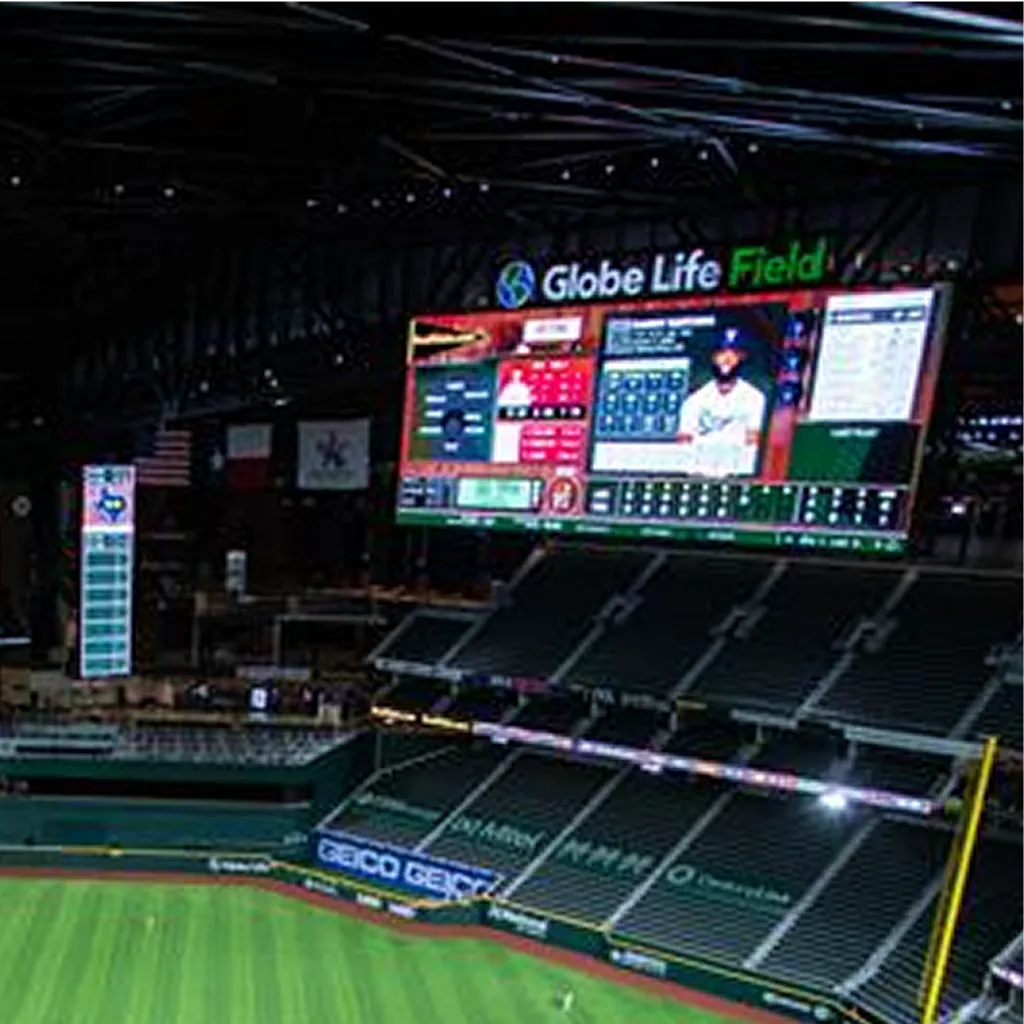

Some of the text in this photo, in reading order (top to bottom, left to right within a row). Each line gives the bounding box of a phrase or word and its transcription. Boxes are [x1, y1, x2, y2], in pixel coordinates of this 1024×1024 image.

[542, 239, 824, 300] Globe Life Field
[317, 838, 400, 878] GEICO
